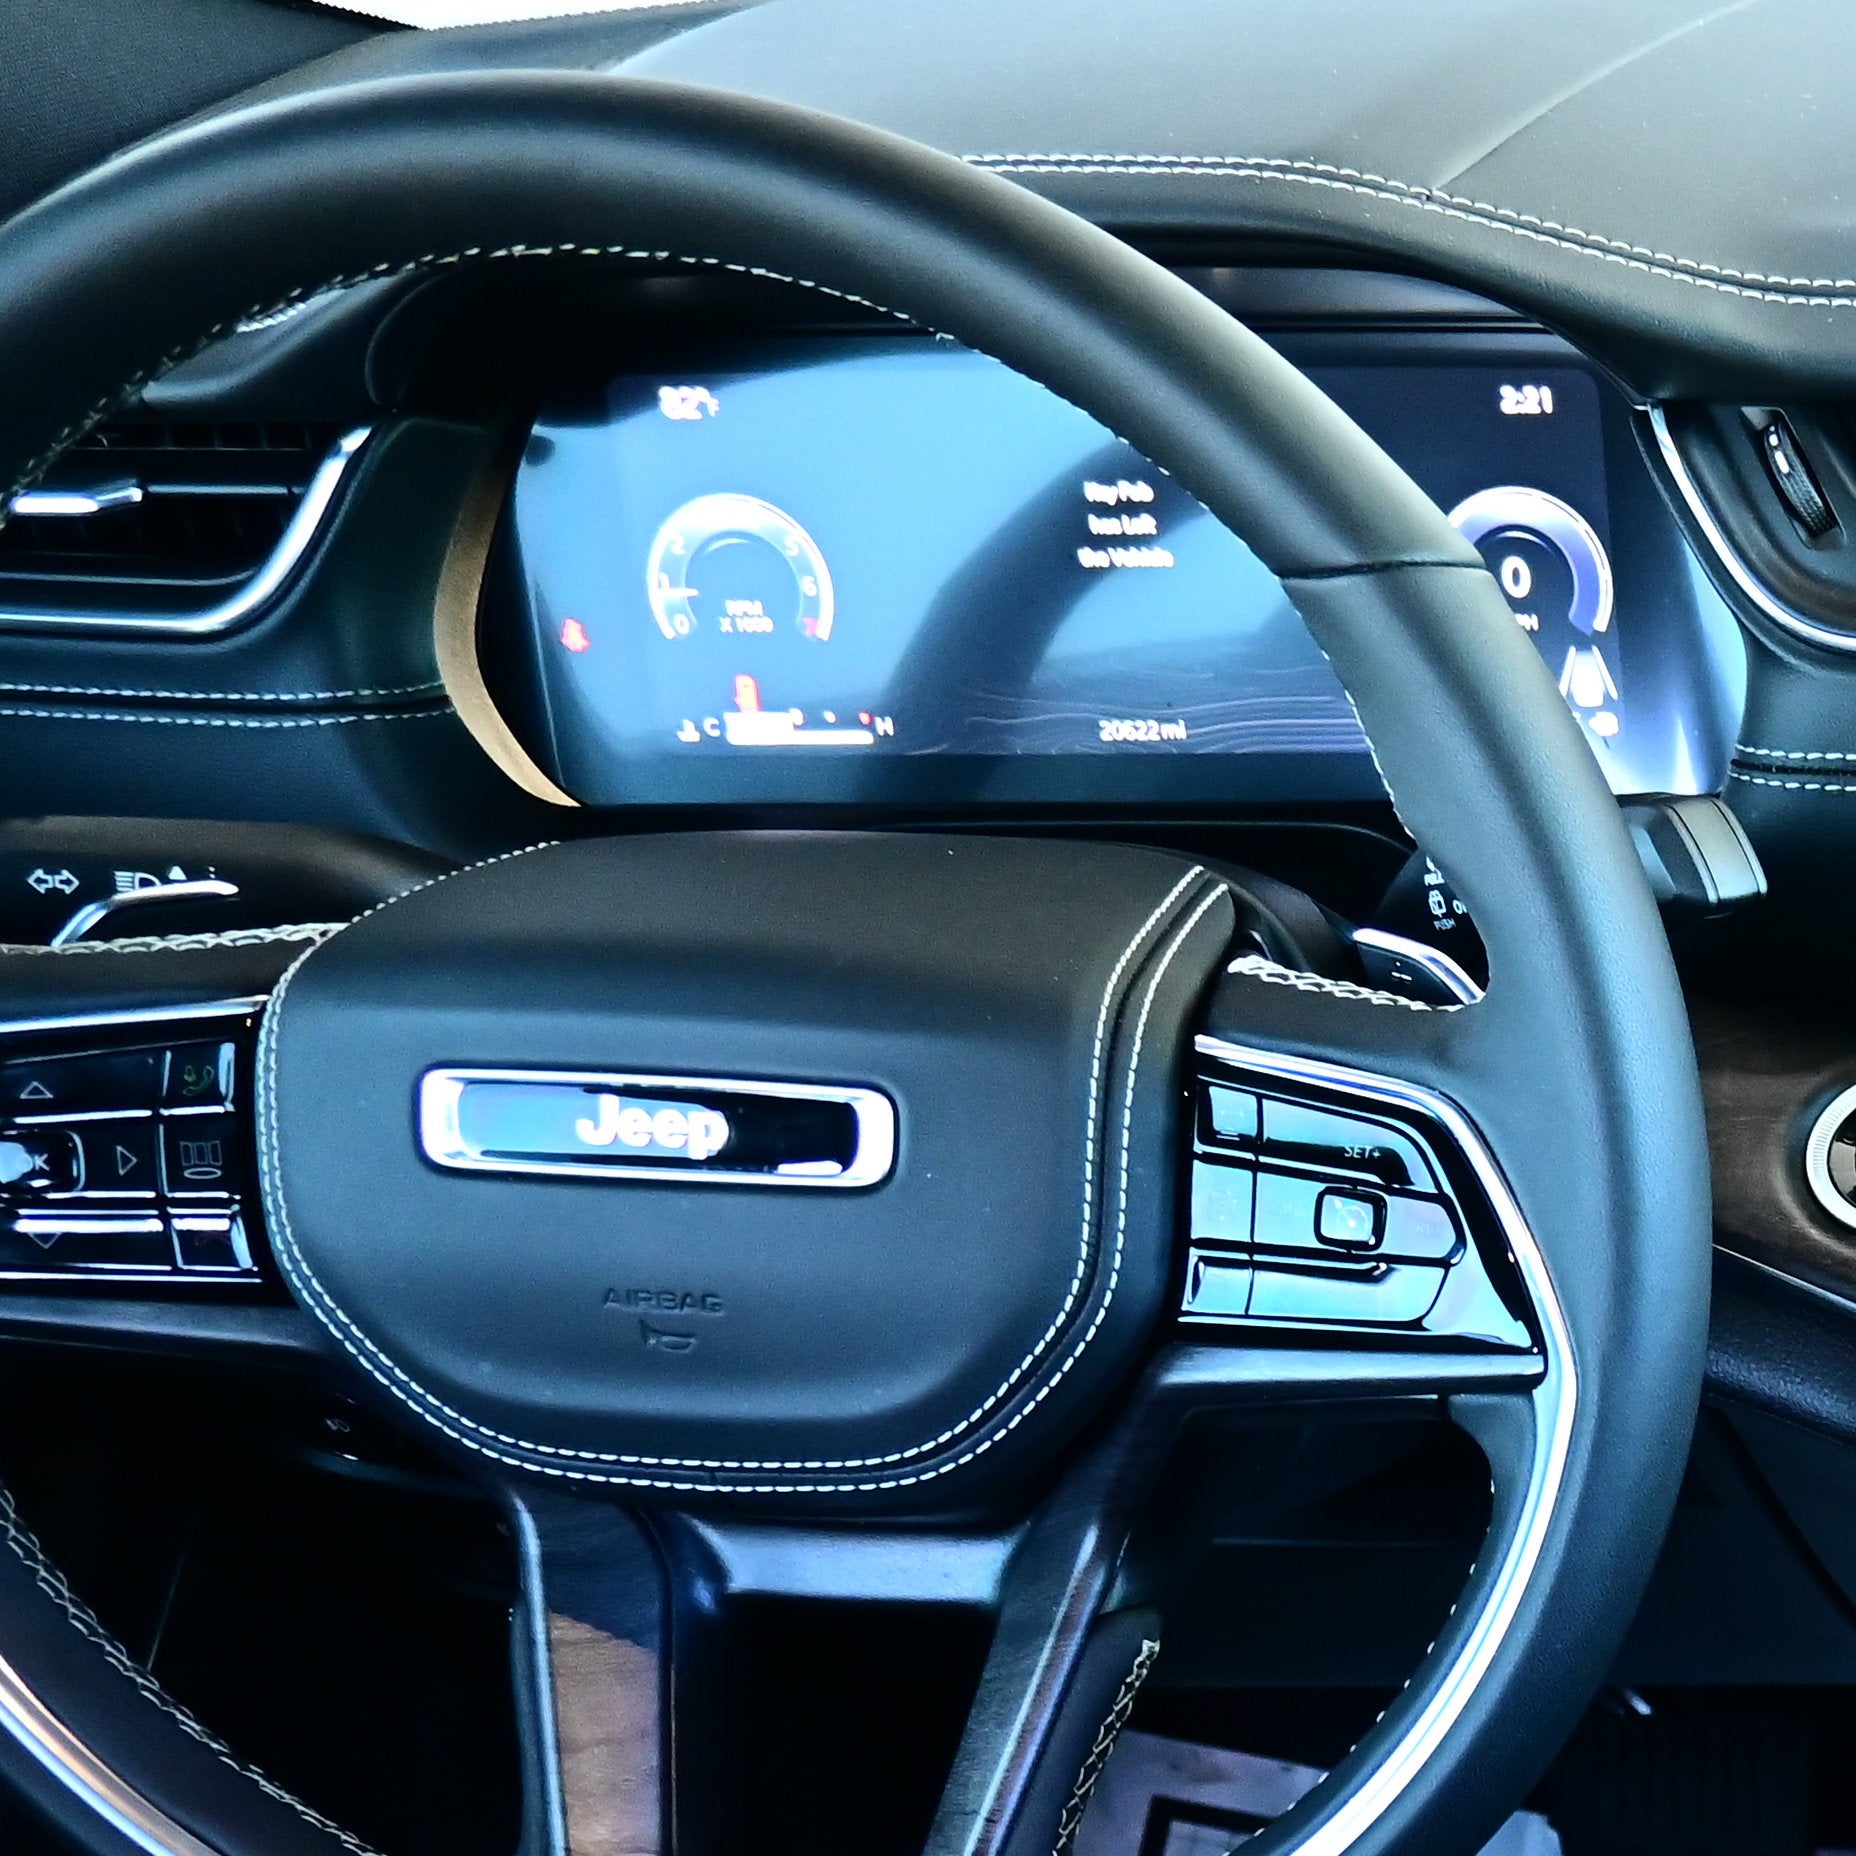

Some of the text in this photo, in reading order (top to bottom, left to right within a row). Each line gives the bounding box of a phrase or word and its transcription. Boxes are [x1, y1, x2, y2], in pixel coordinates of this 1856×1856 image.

[1500, 385, 1553, 415] 2:21
[802, 576, 818, 598] 6
[1501, 556, 1532, 599] 0
[673, 614, 690, 635] 0
[1512, 613, 1540, 632] PH
[704, 717, 721, 738] C
[876, 716, 894, 736] H
[575, 1093, 730, 1161] Jeep
[1343, 1144, 1382, 1160] SET+
[603, 1287, 724, 1316] AIRBAG
